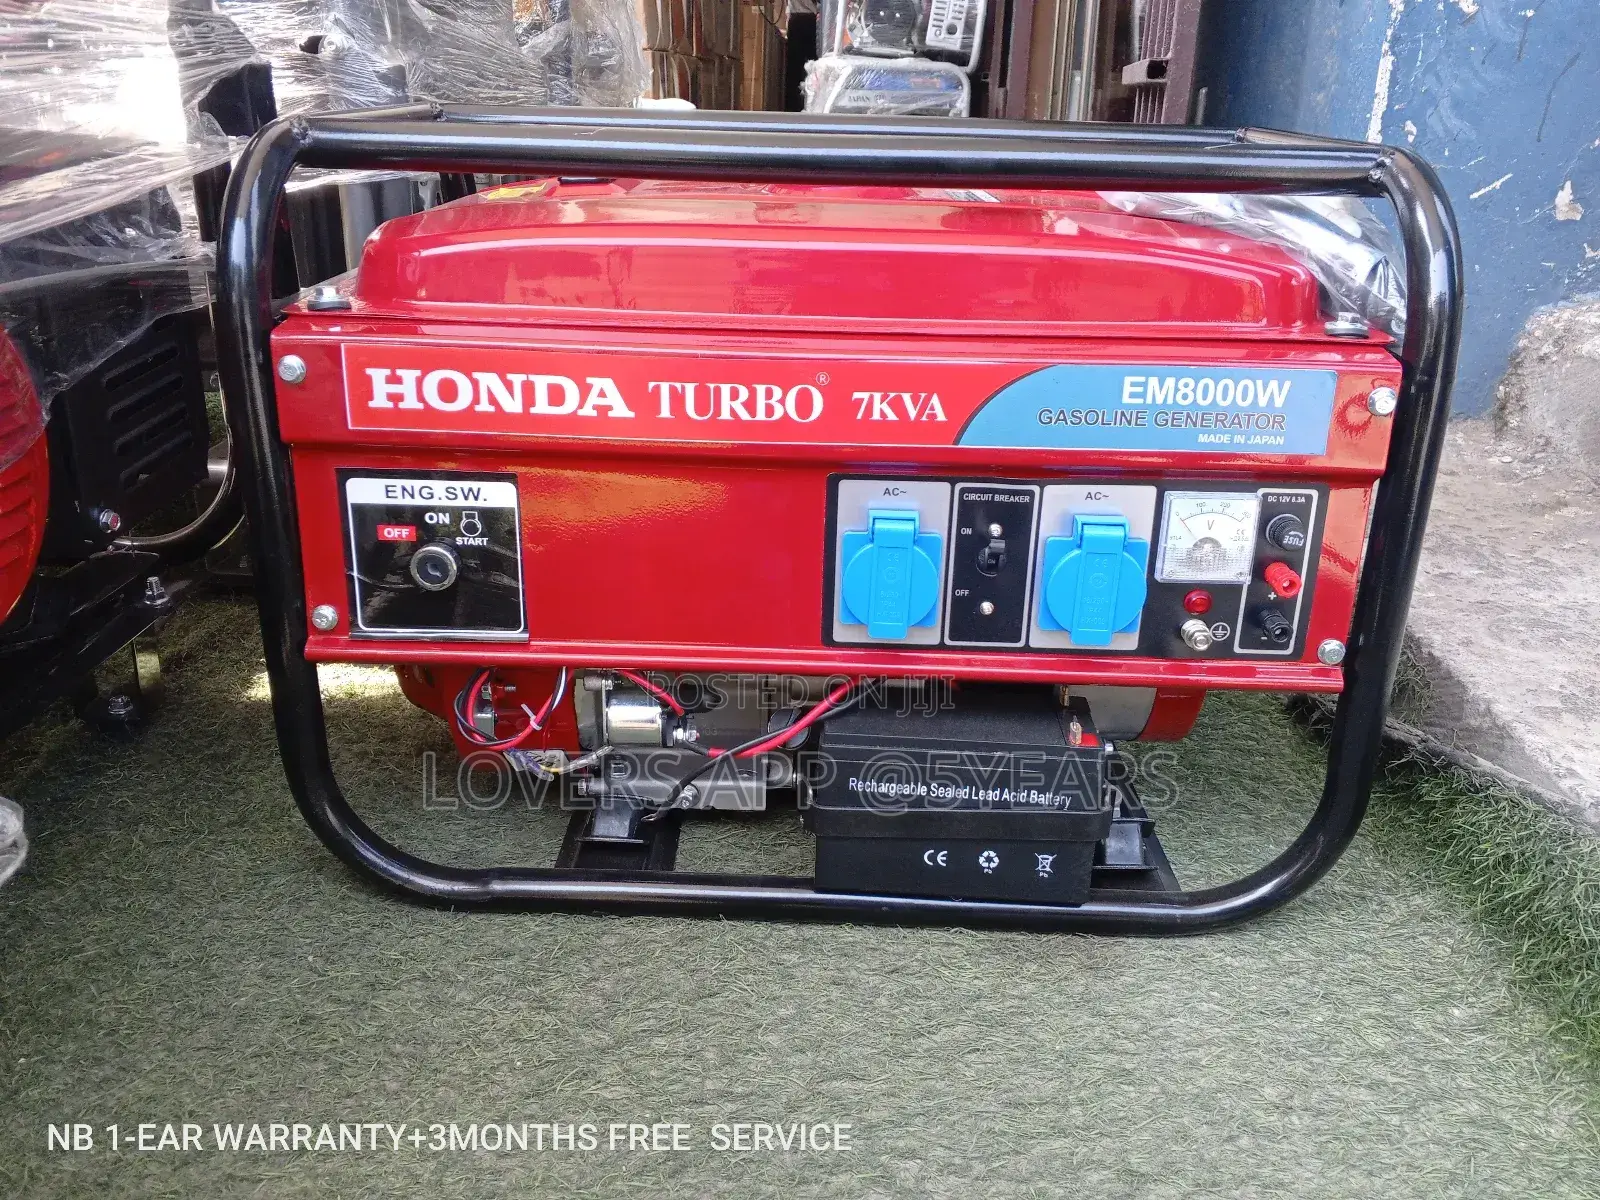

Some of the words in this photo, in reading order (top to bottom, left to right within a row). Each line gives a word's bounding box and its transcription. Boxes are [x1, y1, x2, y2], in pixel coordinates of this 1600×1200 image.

[365, 367, 636, 418] HONDA
[648, 381, 824, 423] TURBO
[851, 391, 948, 422] 7KVA
[1121, 375, 1292, 408] EM8000W
[1037, 407, 1149, 428] GASOLINE
[1153, 410, 1287, 431] GENERATOR
[1197, 433, 1231, 444] MADE
[1233, 434, 1245, 444] IN
[1246, 434, 1285, 445] JAPAN
[384, 484, 488, 502] ENG.SW.
[963, 492, 993, 501] CIRCUIT
[994, 494, 1030, 503] BREAKER
[1267, 495, 1278, 503] DC
[1279, 495, 1291, 503] 12V
[424, 512, 450, 525] ON
[383, 527, 410, 539] OFF
[960, 527, 972, 535] ON
[455, 536, 489, 546] START
[1282, 534, 1305, 547] FUSE
[954, 589, 970, 597] OFF
[849, 777, 928, 797] Rechargeable
[930, 782, 969, 799] Sealed
[971, 785, 1000, 802] Lead
[1001, 787, 1028, 803] Acid
[1029, 789, 1072, 811] Battery
